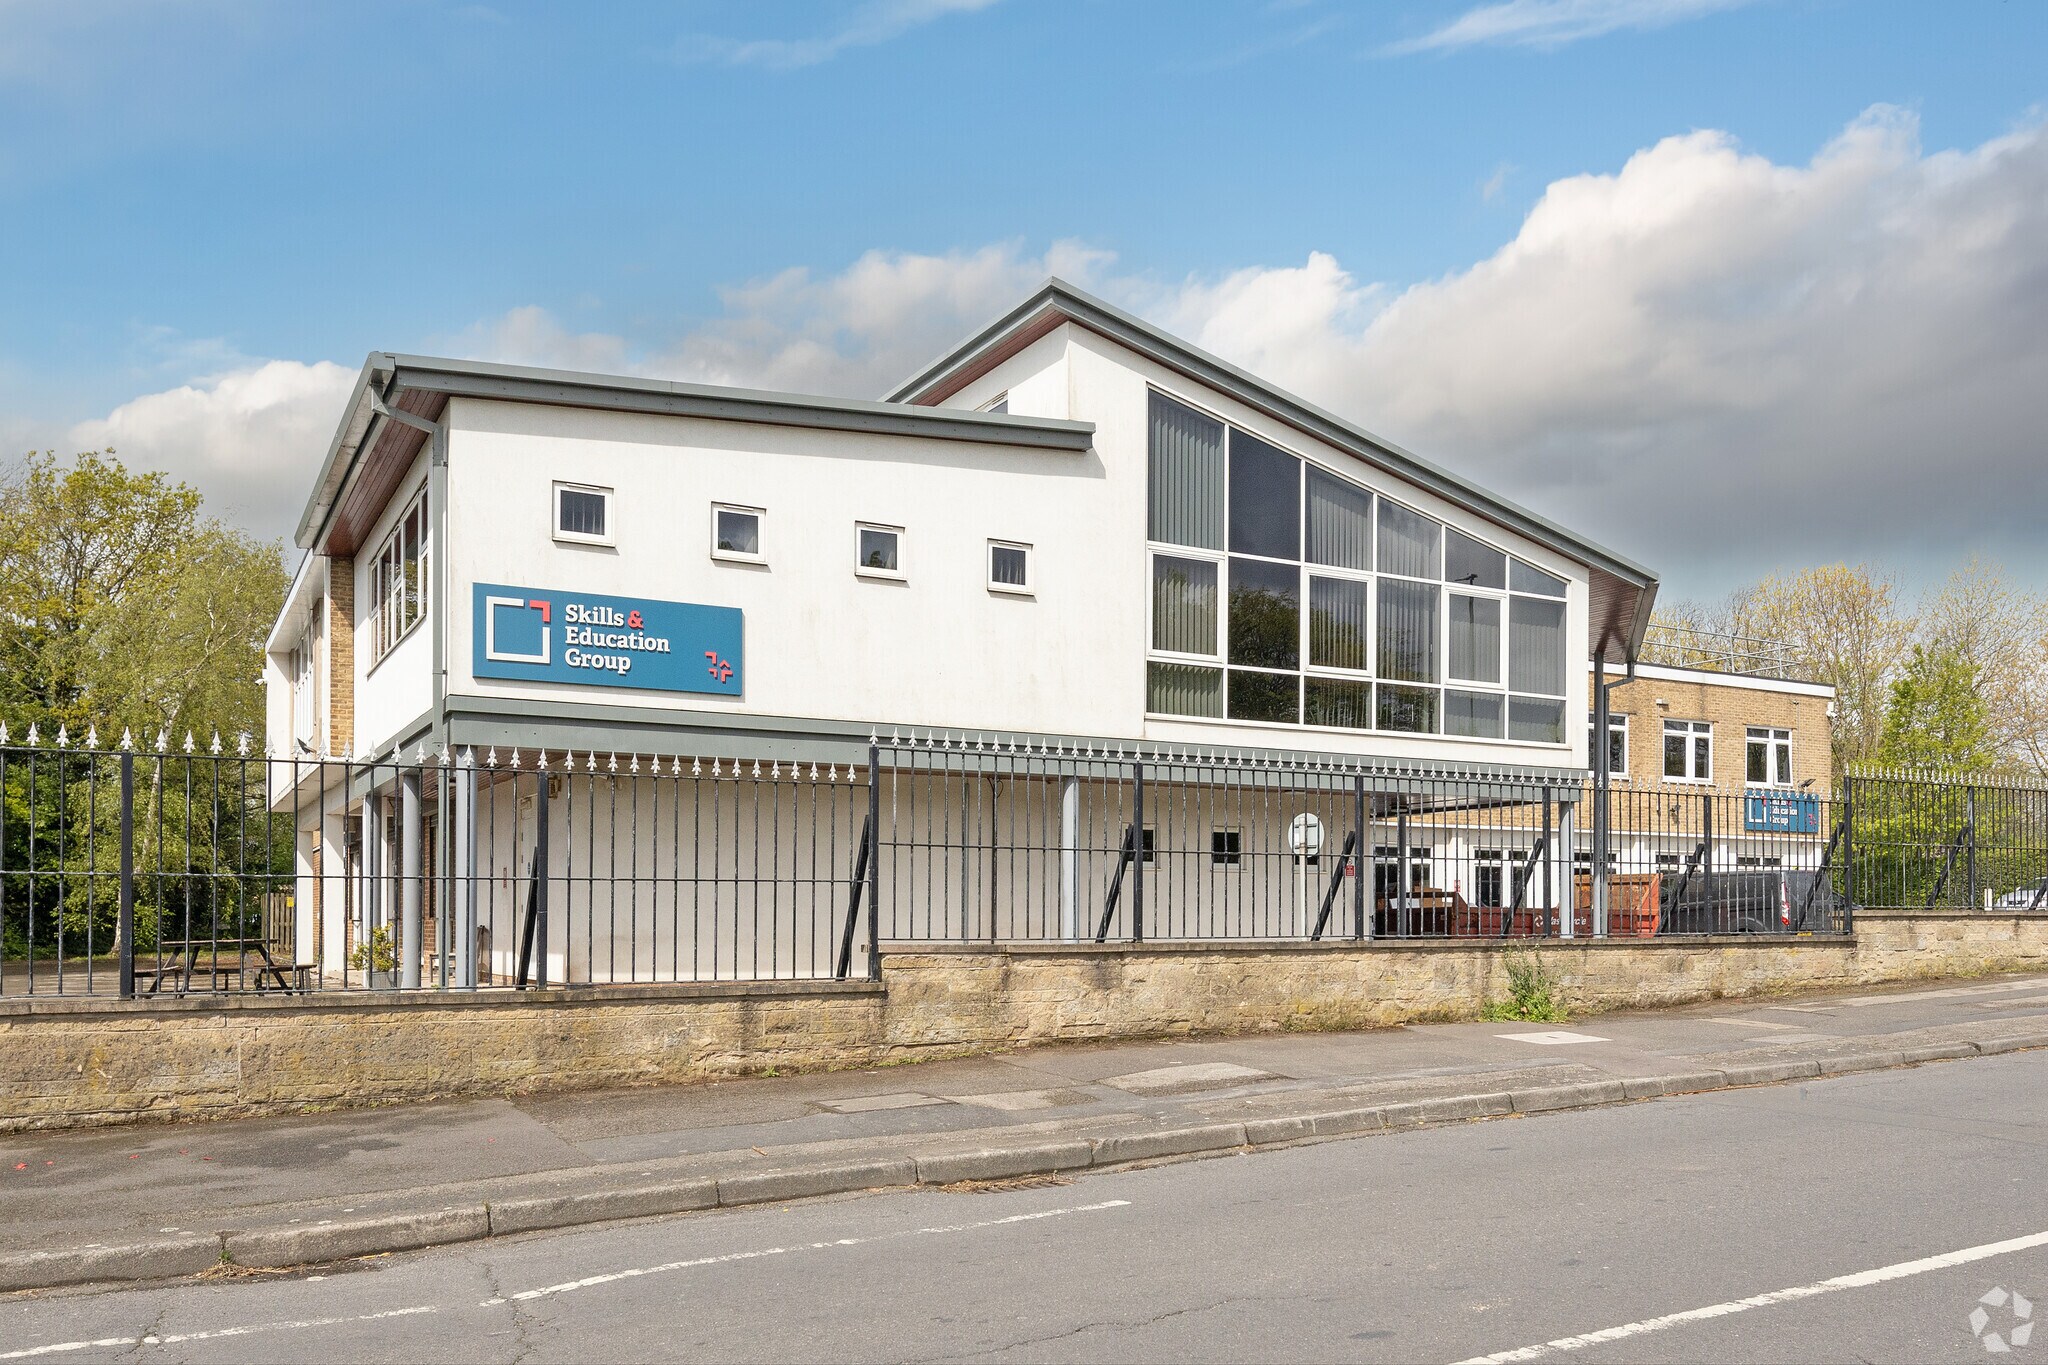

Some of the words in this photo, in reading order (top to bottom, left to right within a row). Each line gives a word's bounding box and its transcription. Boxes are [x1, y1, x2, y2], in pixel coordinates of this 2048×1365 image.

[565, 604, 624, 626] Skills
[627, 610, 644, 629] &
[565, 626, 670, 652] Education
[565, 648, 631, 674] Group
